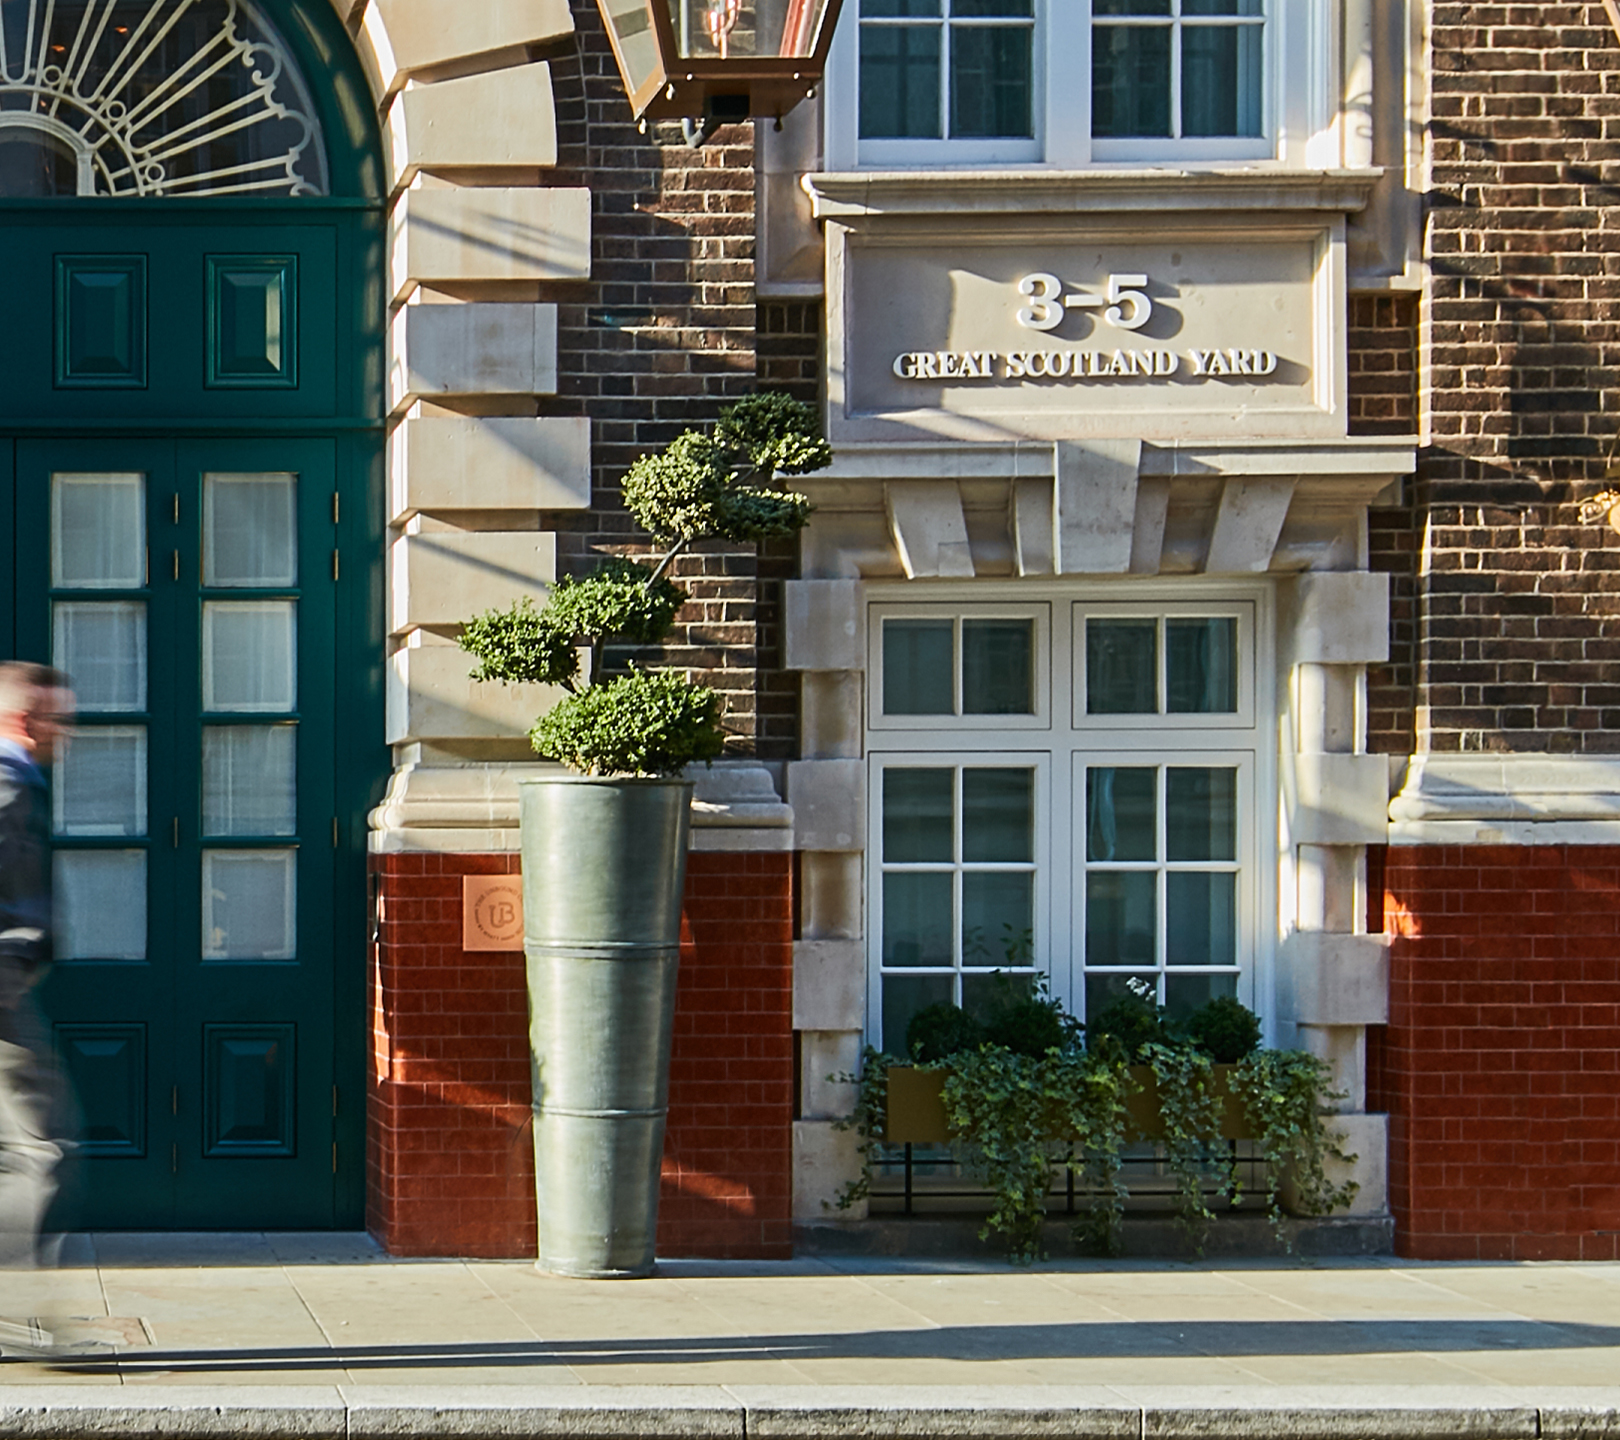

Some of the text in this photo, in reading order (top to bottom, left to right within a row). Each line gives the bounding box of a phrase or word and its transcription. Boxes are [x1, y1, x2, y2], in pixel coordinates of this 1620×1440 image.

[893, 348, 1277, 379] GREAT SCOTLAND YARD
